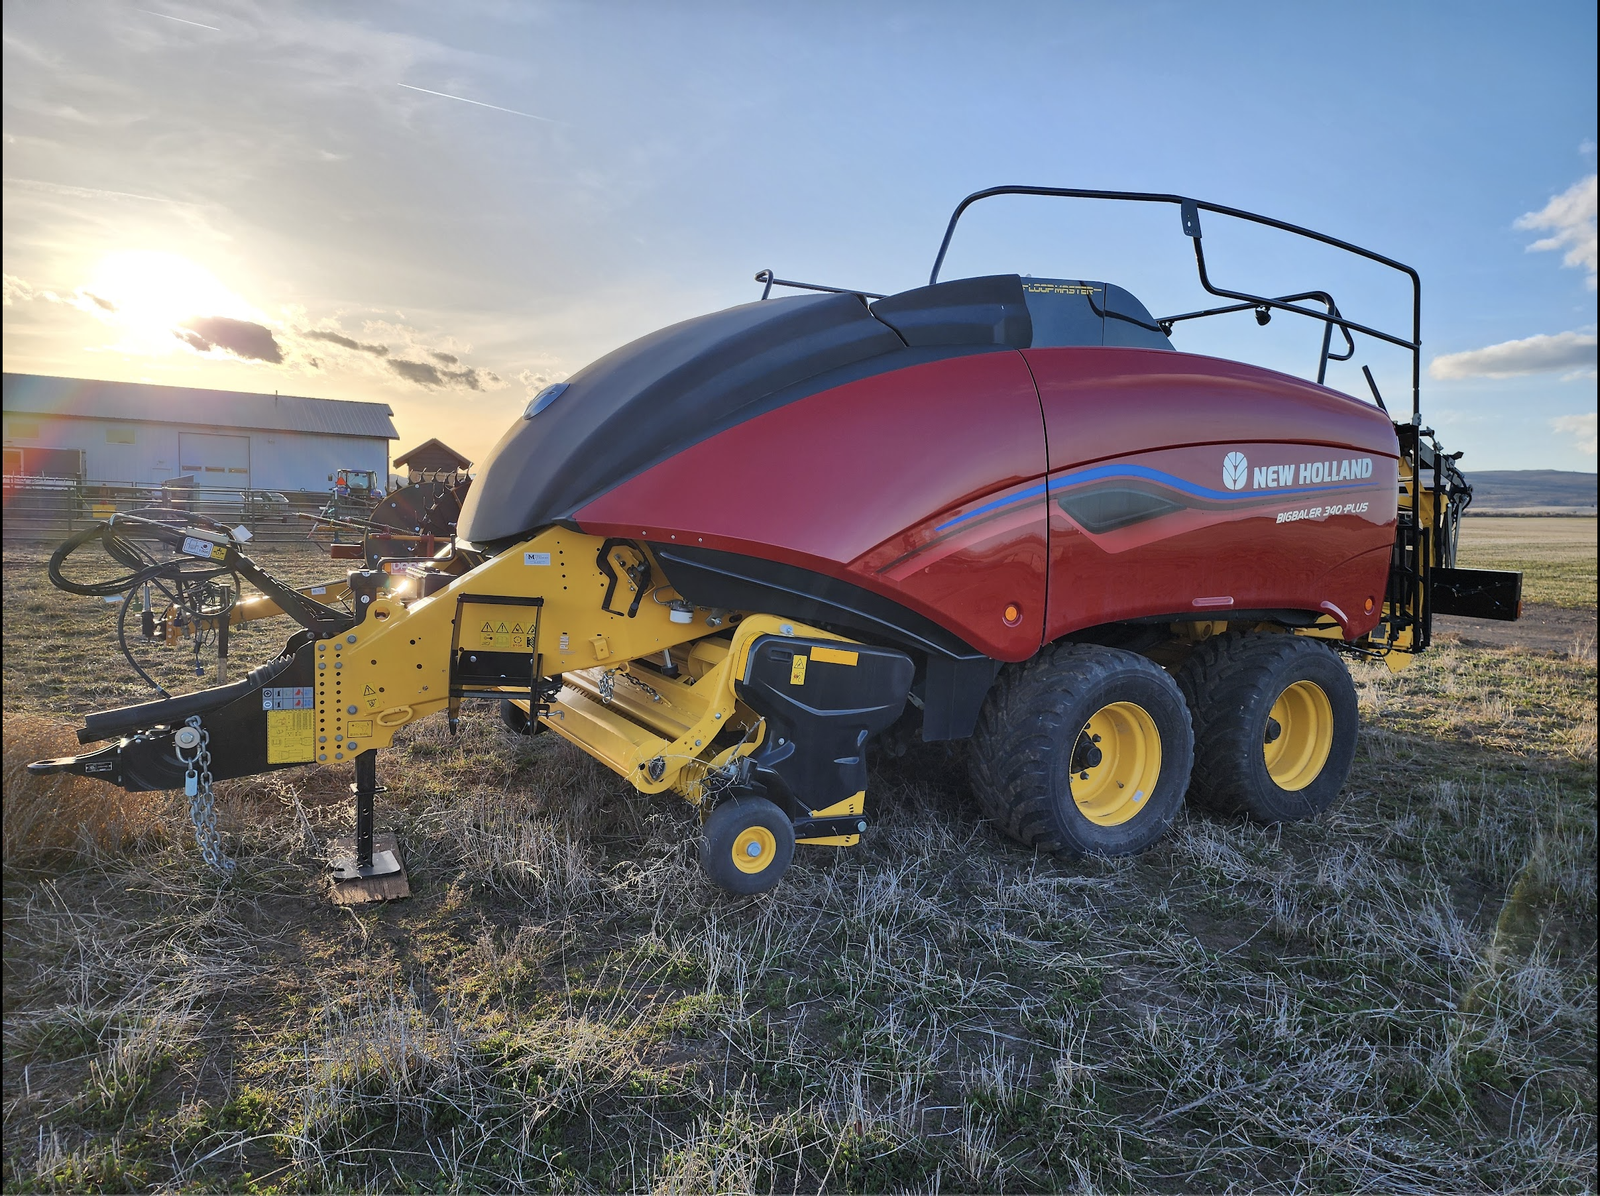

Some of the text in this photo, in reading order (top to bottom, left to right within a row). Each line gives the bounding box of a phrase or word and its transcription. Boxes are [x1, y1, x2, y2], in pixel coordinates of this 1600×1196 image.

[1253, 458, 1373, 489] NEW HOLLAND
[1276, 507, 1322, 524] BIGBALER
[1323, 505, 1342, 517] 340
